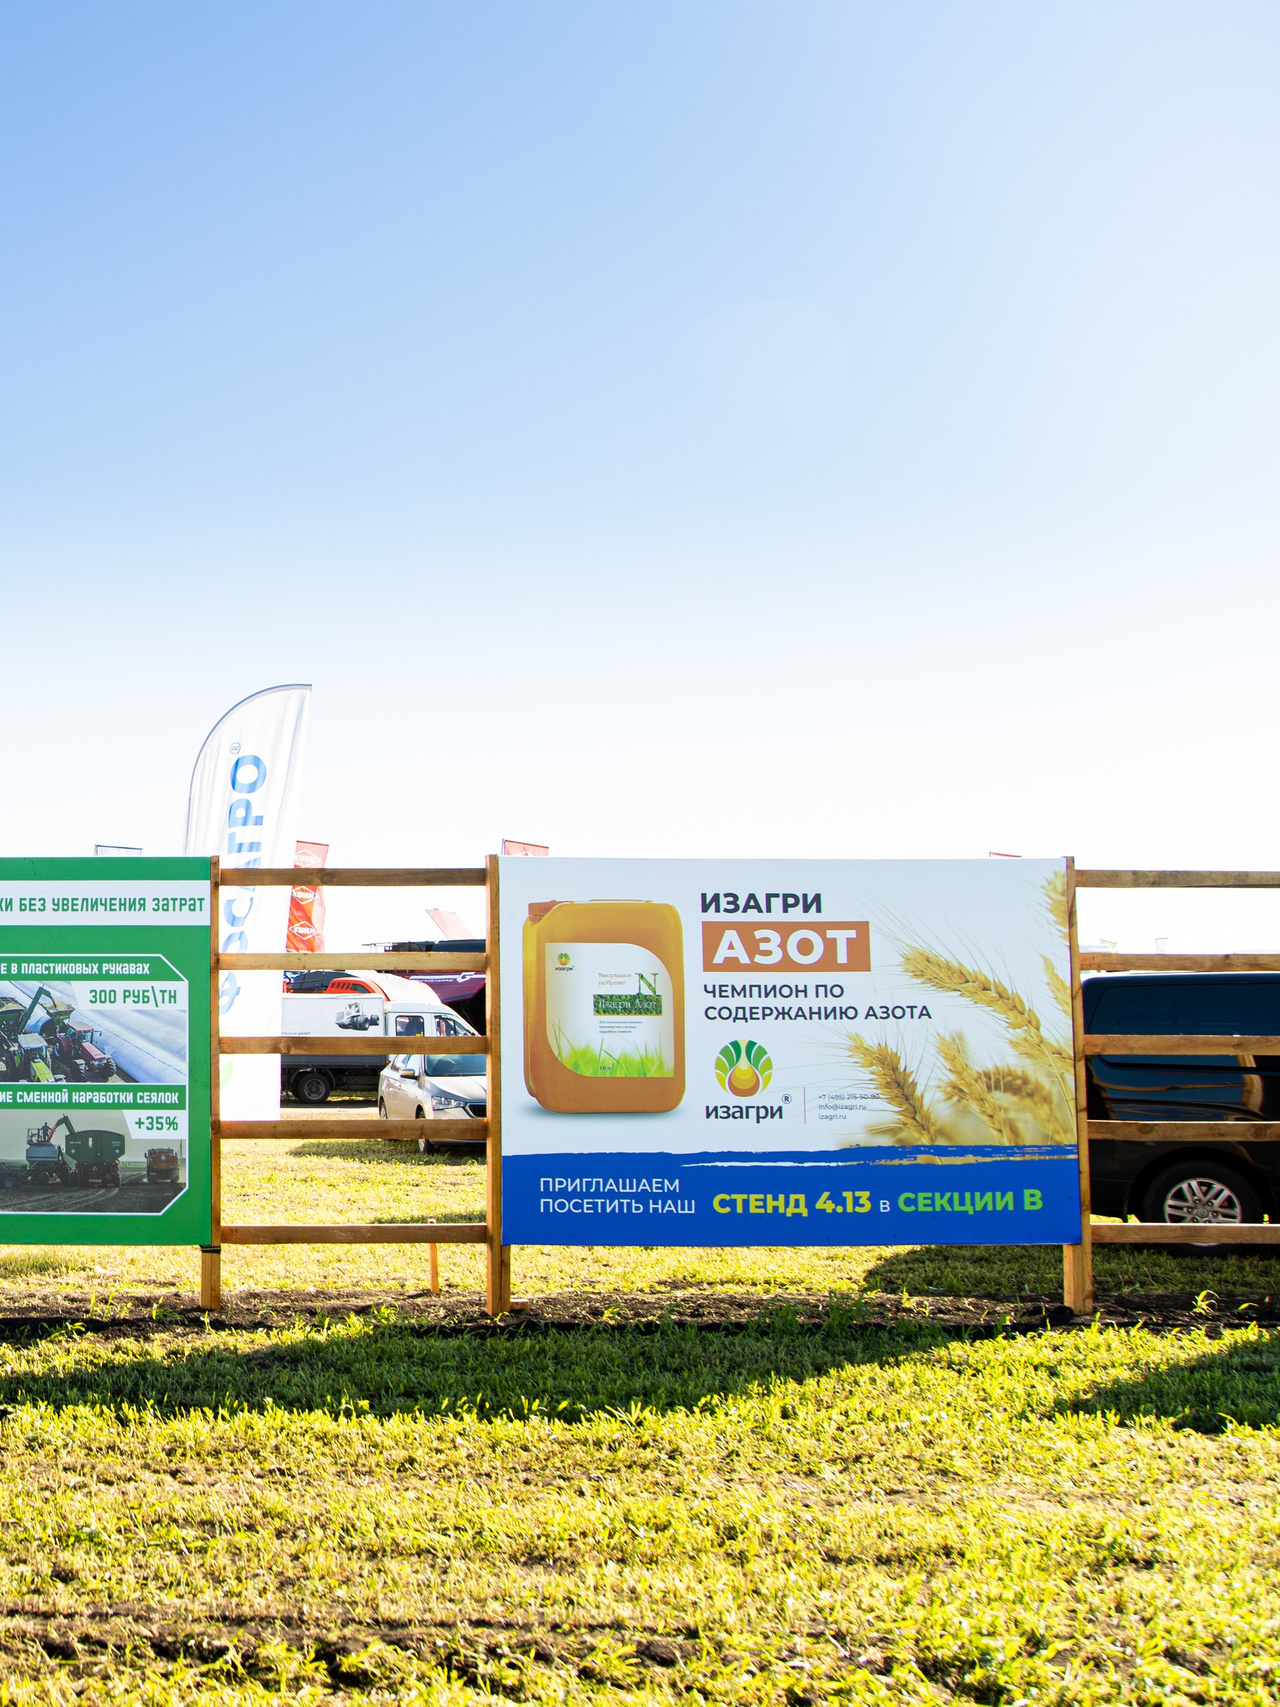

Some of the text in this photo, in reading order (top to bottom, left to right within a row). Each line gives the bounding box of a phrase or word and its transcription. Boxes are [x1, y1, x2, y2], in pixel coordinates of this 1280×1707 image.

[19, 897, 46, 912] БЕЗ
[51, 897, 146, 912] УВЕЛИЧЕНИЯ
[700, 892, 822, 913] ИЗАГРИ
[712, 929, 857, 965] АЗОТ
[11, 963, 18, 974] В
[89, 989, 117, 1004] 300
[703, 984, 845, 998] ЧЕМПИОН ПО
[704, 1005, 932, 1023] СОДЕРЖАНИЮ АЗОТА
[16, 1089, 69, 1103] СМЕННОЙ
[136, 1092, 179, 1104] СЕЯЛОК
[818, 1102, 867, 1111] info@izagri.ru
[705, 1105, 783, 1124] изагри
[818, 1112, 847, 1121] izagri.ru
[135, 1116, 179, 1131] +35%
[540, 1178, 680, 1193] ПРИГЛАШАЕМ
[540, 1199, 695, 1214] ПОСЕТИТЬ НАШ
[712, 1193, 808, 1217] СТЕНД
[815, 1191, 871, 1213] 4.13
[898, 1192, 1014, 1215] СЕКЦИИ
[1023, 1189, 1043, 1211] В
